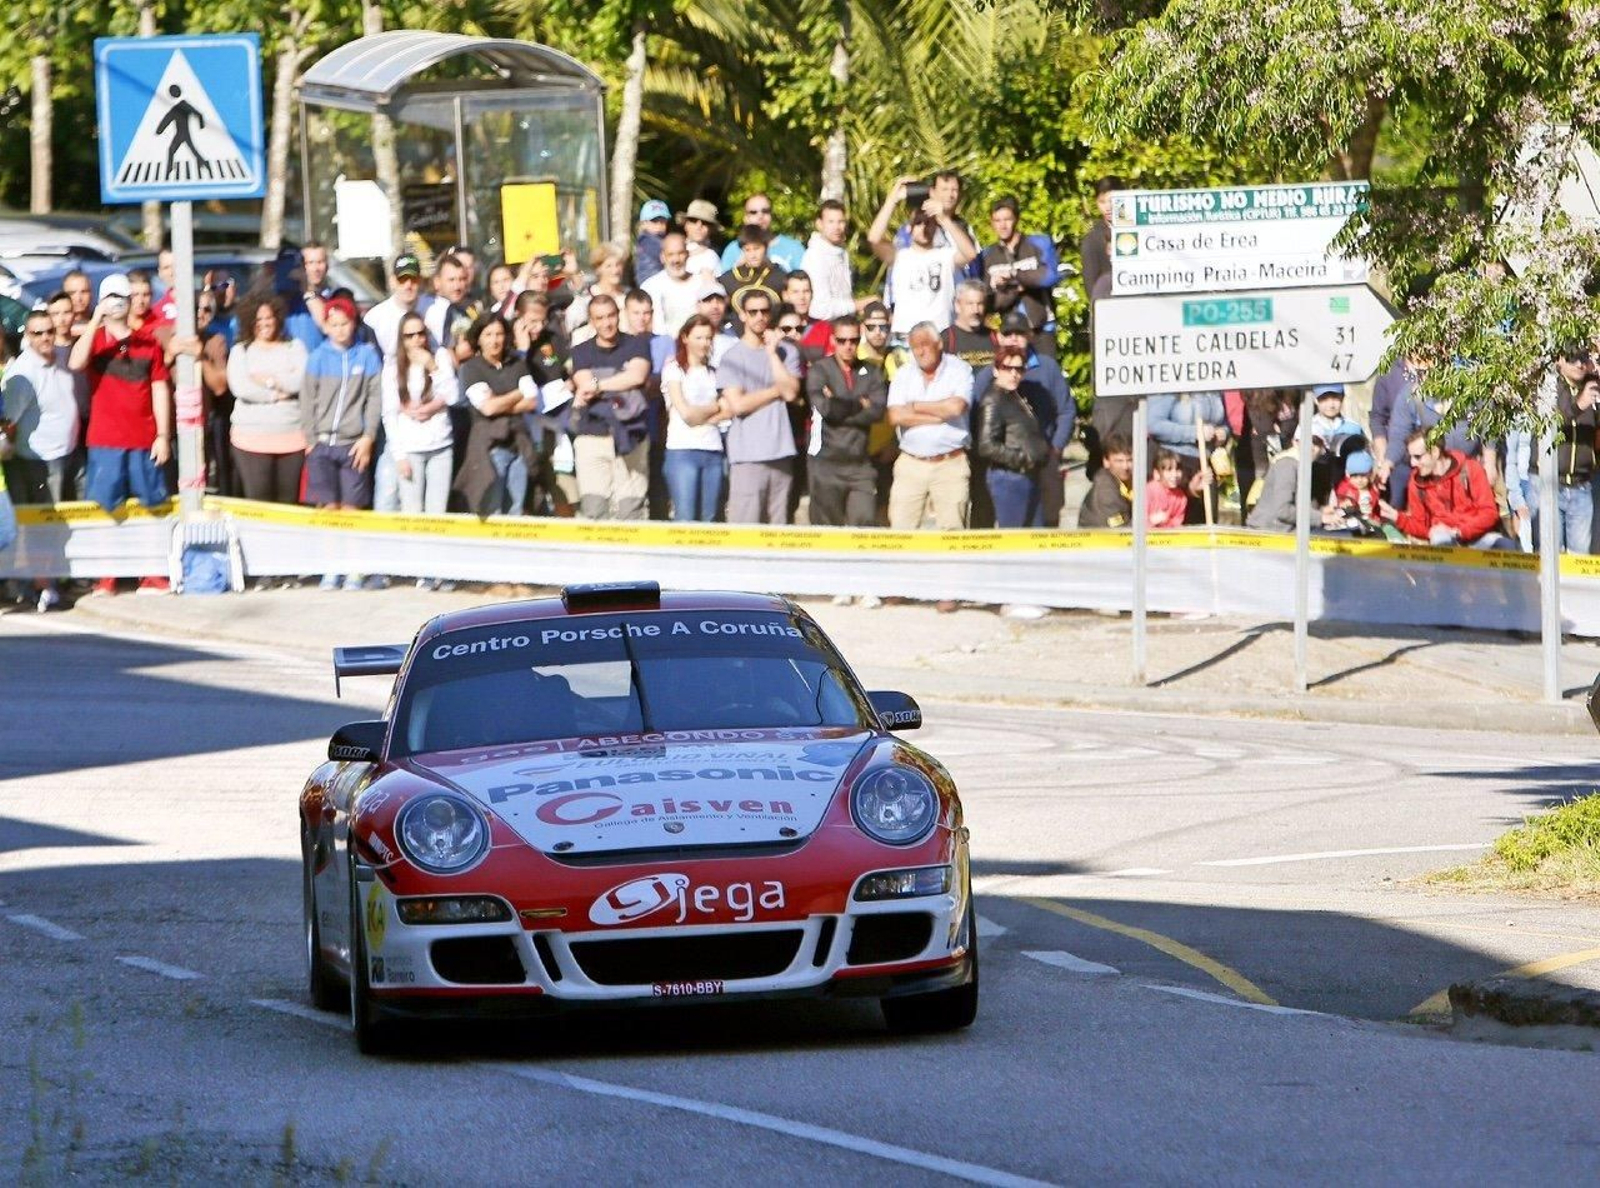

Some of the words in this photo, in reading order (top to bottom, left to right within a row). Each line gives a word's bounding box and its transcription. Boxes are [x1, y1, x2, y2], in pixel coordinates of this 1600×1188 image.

[1137, 192, 1215, 213] TURISMO
[1220, 191, 1247, 209] NO
[1253, 188, 1307, 208] MEDIO
[1145, 235, 1185, 252] Casa
[1192, 233, 1213, 249] de
[1220, 233, 1258, 248] Erea
[1117, 268, 1195, 288] Camping
[1189, 300, 1267, 324] PO-255
[1105, 335, 1182, 357] PUENTE
[1196, 328, 1300, 353] CALDELAS
[1335, 327, 1356, 346] 31
[1105, 360, 1237, 385] PONTEVEDRA
[1330, 354, 1354, 373] 47
[432, 634, 531, 662] Centro
[541, 622, 661, 645] Porsche
[671, 622, 691, 636] A
[699, 620, 803, 638] Coruña
[577, 731, 765, 748] ABEGONDO
[488, 764, 835, 804] Panasonic
[675, 878, 785, 923] jega
[654, 981, 721, 997] S-7610-BBY
